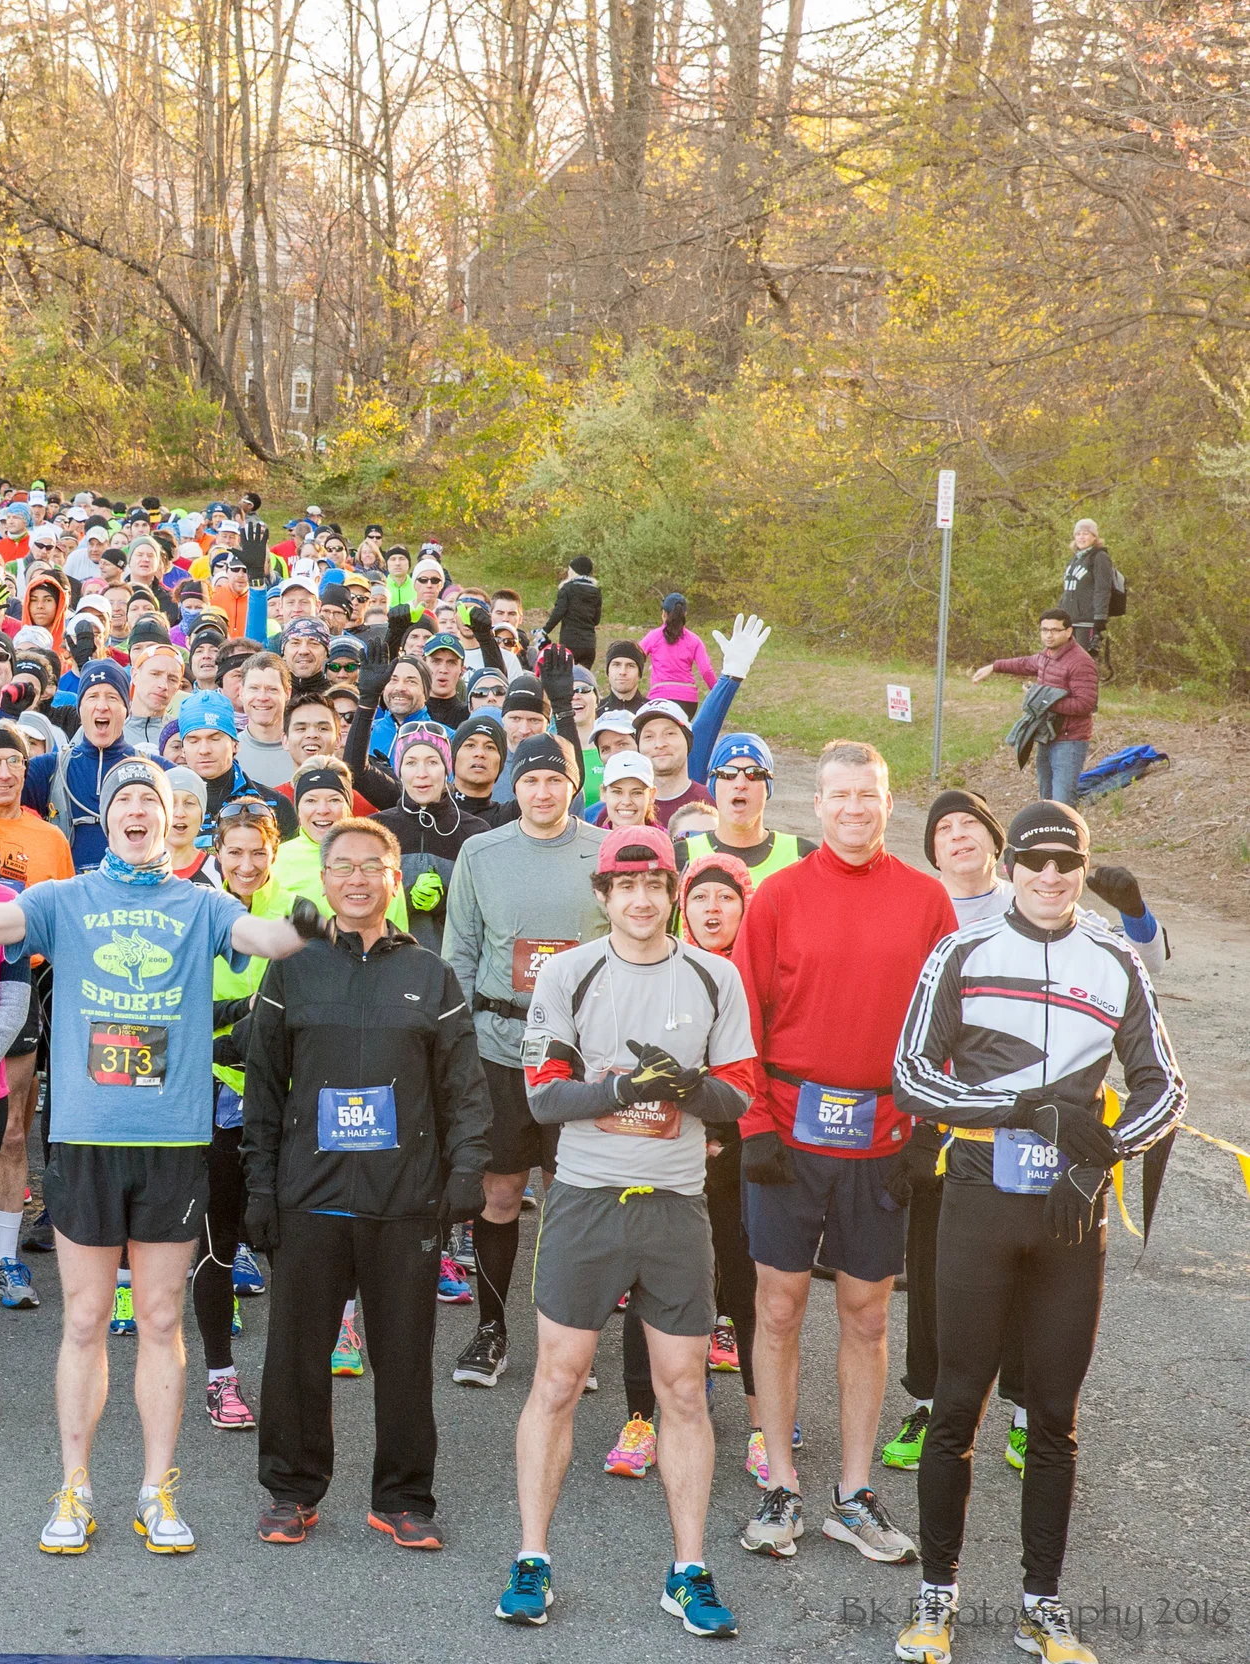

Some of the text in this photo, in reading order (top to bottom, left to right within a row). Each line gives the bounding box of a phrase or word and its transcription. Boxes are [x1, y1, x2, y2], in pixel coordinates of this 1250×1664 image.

[1020, 826, 1077, 841] DEUTSCHLAND
[83, 909, 186, 937] VARSITY
[81, 979, 183, 1012] SPORTS
[122, 1024, 149, 1033] amazing
[100, 1046, 153, 1075] 313
[337, 1104, 376, 1127] 594
[613, 1109, 666, 1122] MARATHON
[818, 1101, 854, 1125] 521
[347, 1128, 369, 1138] HALF
[824, 1125, 846, 1135] HALF
[1017, 1143, 1059, 1168] 798
[1026, 1169, 1050, 1180] HALF
